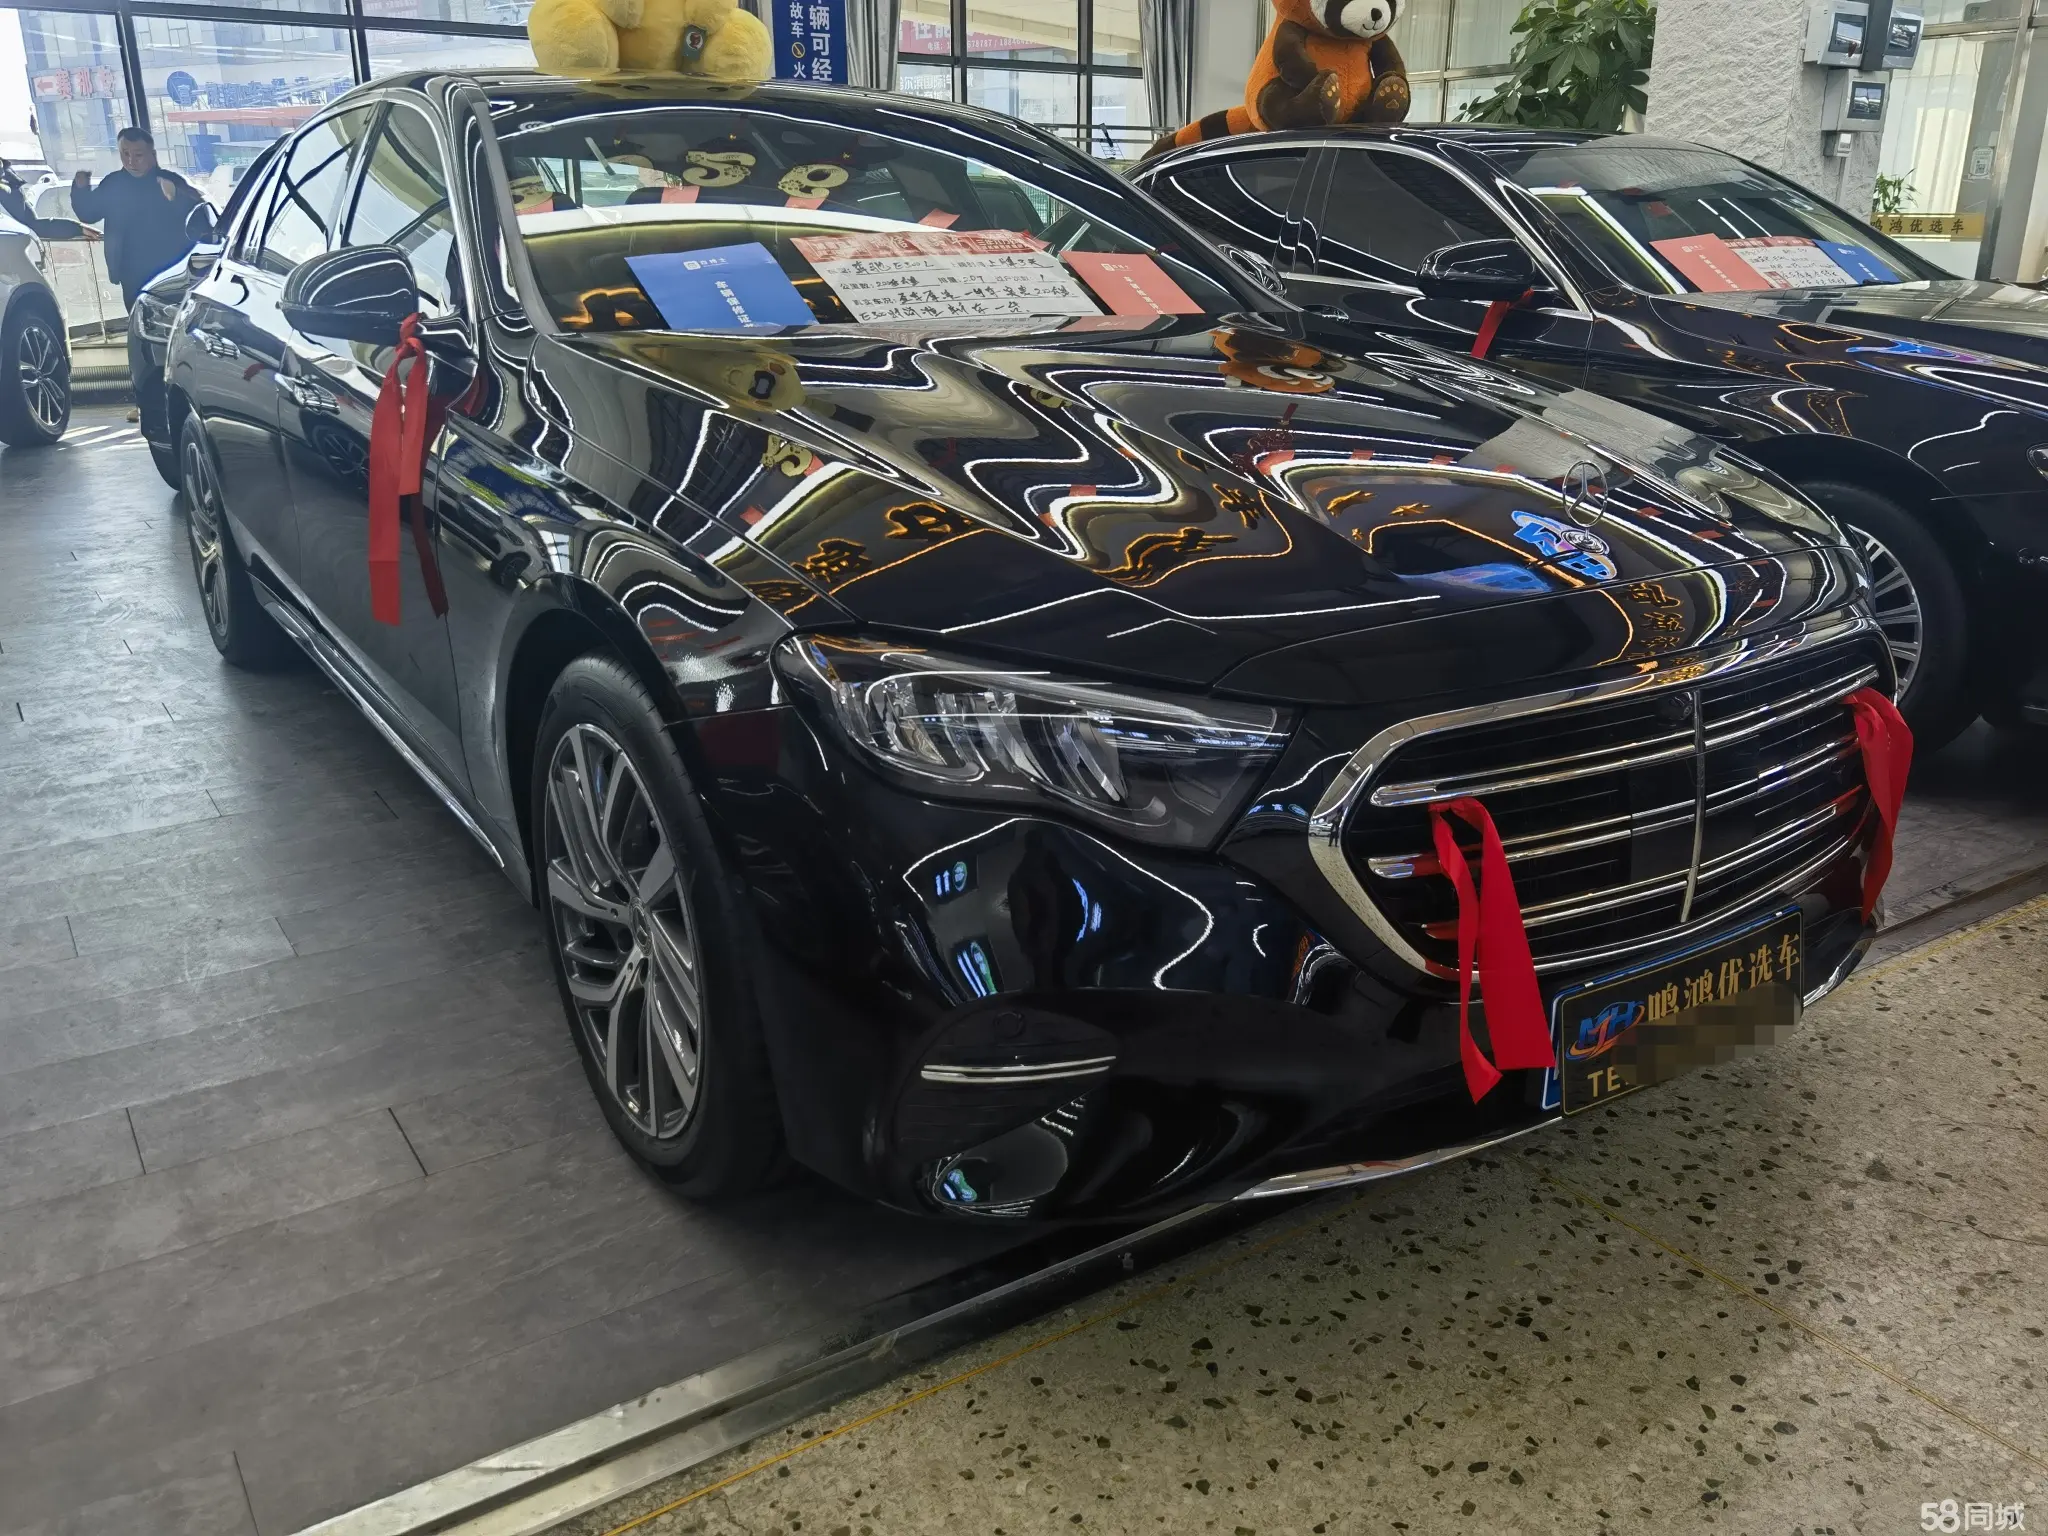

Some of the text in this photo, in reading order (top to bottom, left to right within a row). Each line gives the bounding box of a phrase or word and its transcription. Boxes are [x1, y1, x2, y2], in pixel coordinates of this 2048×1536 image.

[790, 0, 806, 79] 故车 火
[809, 0, 833, 82] 辆可经
[1587, 1066, 1630, 1098] TE
